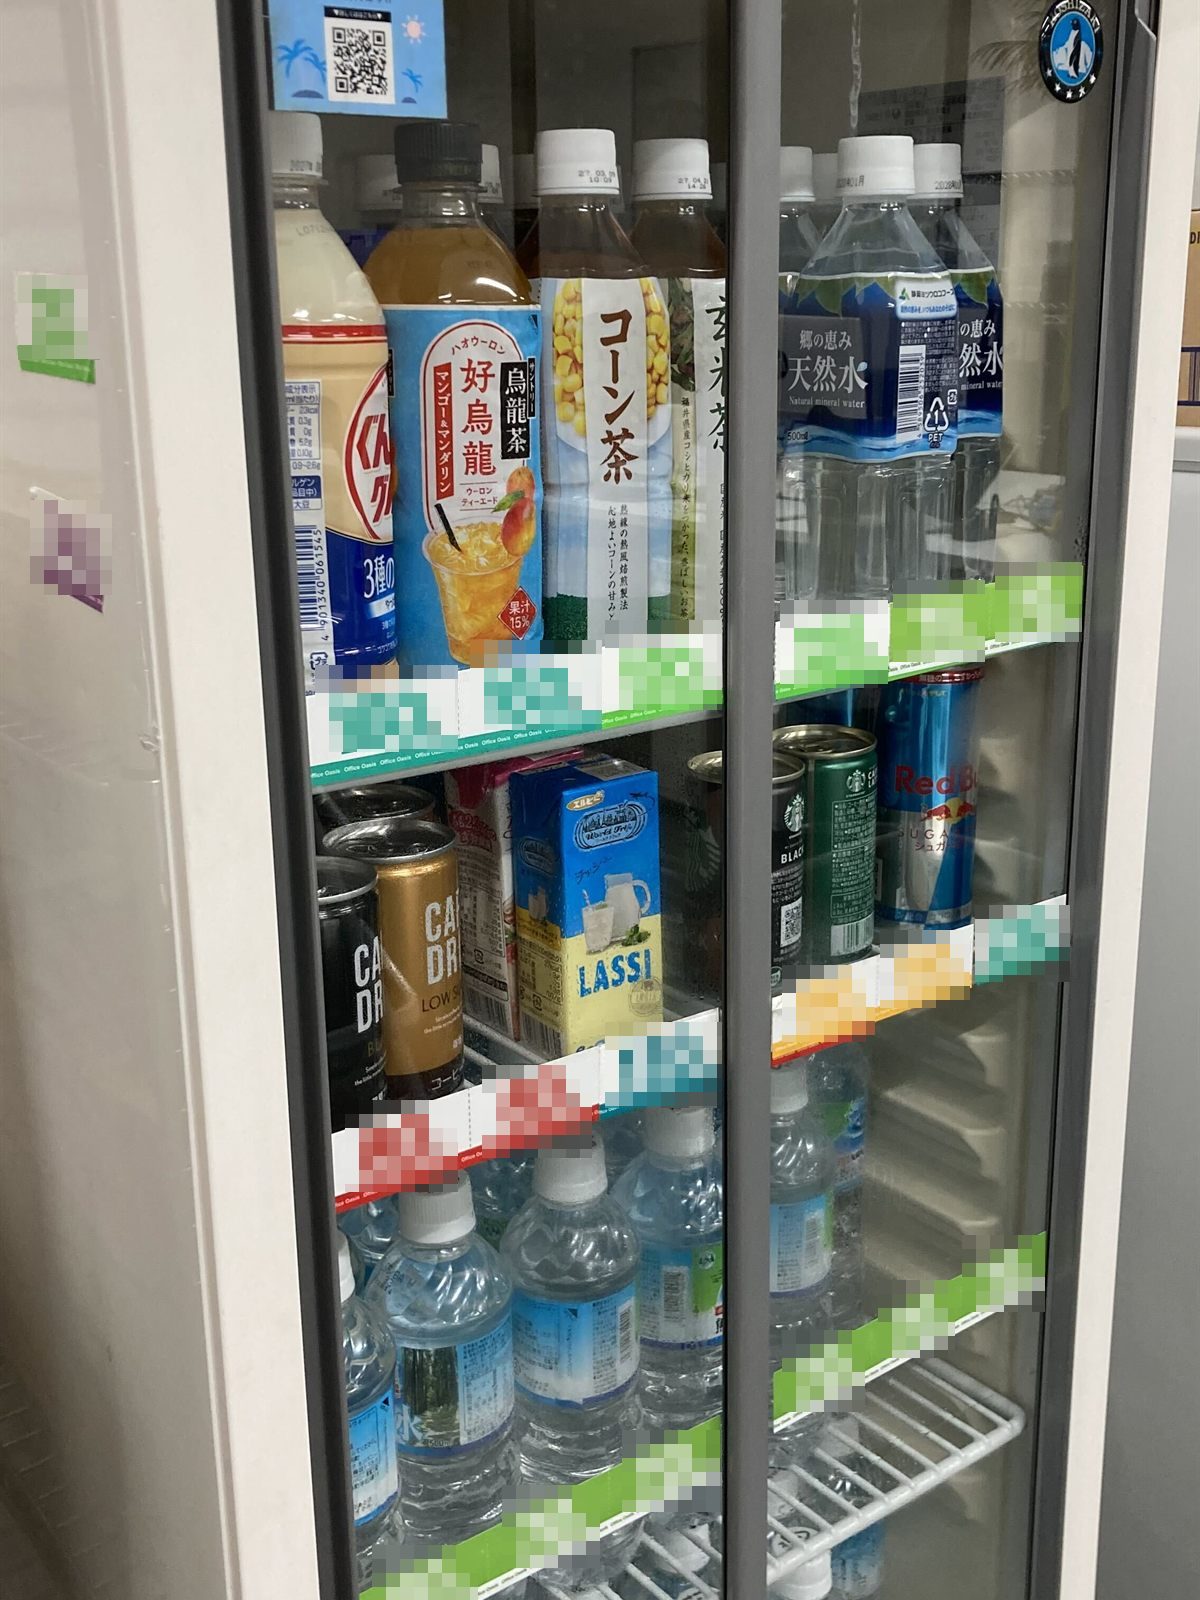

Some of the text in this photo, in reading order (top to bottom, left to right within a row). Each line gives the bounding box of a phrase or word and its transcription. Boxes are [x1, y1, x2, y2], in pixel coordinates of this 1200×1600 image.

[960, 319, 996, 338] の恵み
[451, 336, 506, 355] ハオウーロン
[799, 329, 853, 351] 郷の恵み
[958, 341, 1003, 378] 然水
[787, 355, 869, 394] 天然水
[599, 309, 640, 485] コーン茶
[960, 381, 984, 391] mineral
[505, 367, 528, 454] 烏龍茶
[789, 396, 866, 408] Natural mineral water
[460, 358, 497, 476] 好烏龍
[435, 371, 452, 494] マンゴー&マンダリン
[928, 432, 943, 442] PET
[461, 496, 499, 508] ティーエード
[466, 487, 493, 495] ウーロン
[313, 529, 326, 575] 061545
[363, 554, 396, 599] 3種の
[509, 600, 531, 614] 果汁
[509, 614, 530, 630] 15%
[481, 738, 496, 746] Office
[343, 765, 360, 773] Office
[380, 758, 396, 766] Office
[895, 765, 956, 796] Red
[578, 948, 652, 998] LASSI
[421, 990, 452, 1013] LOW
